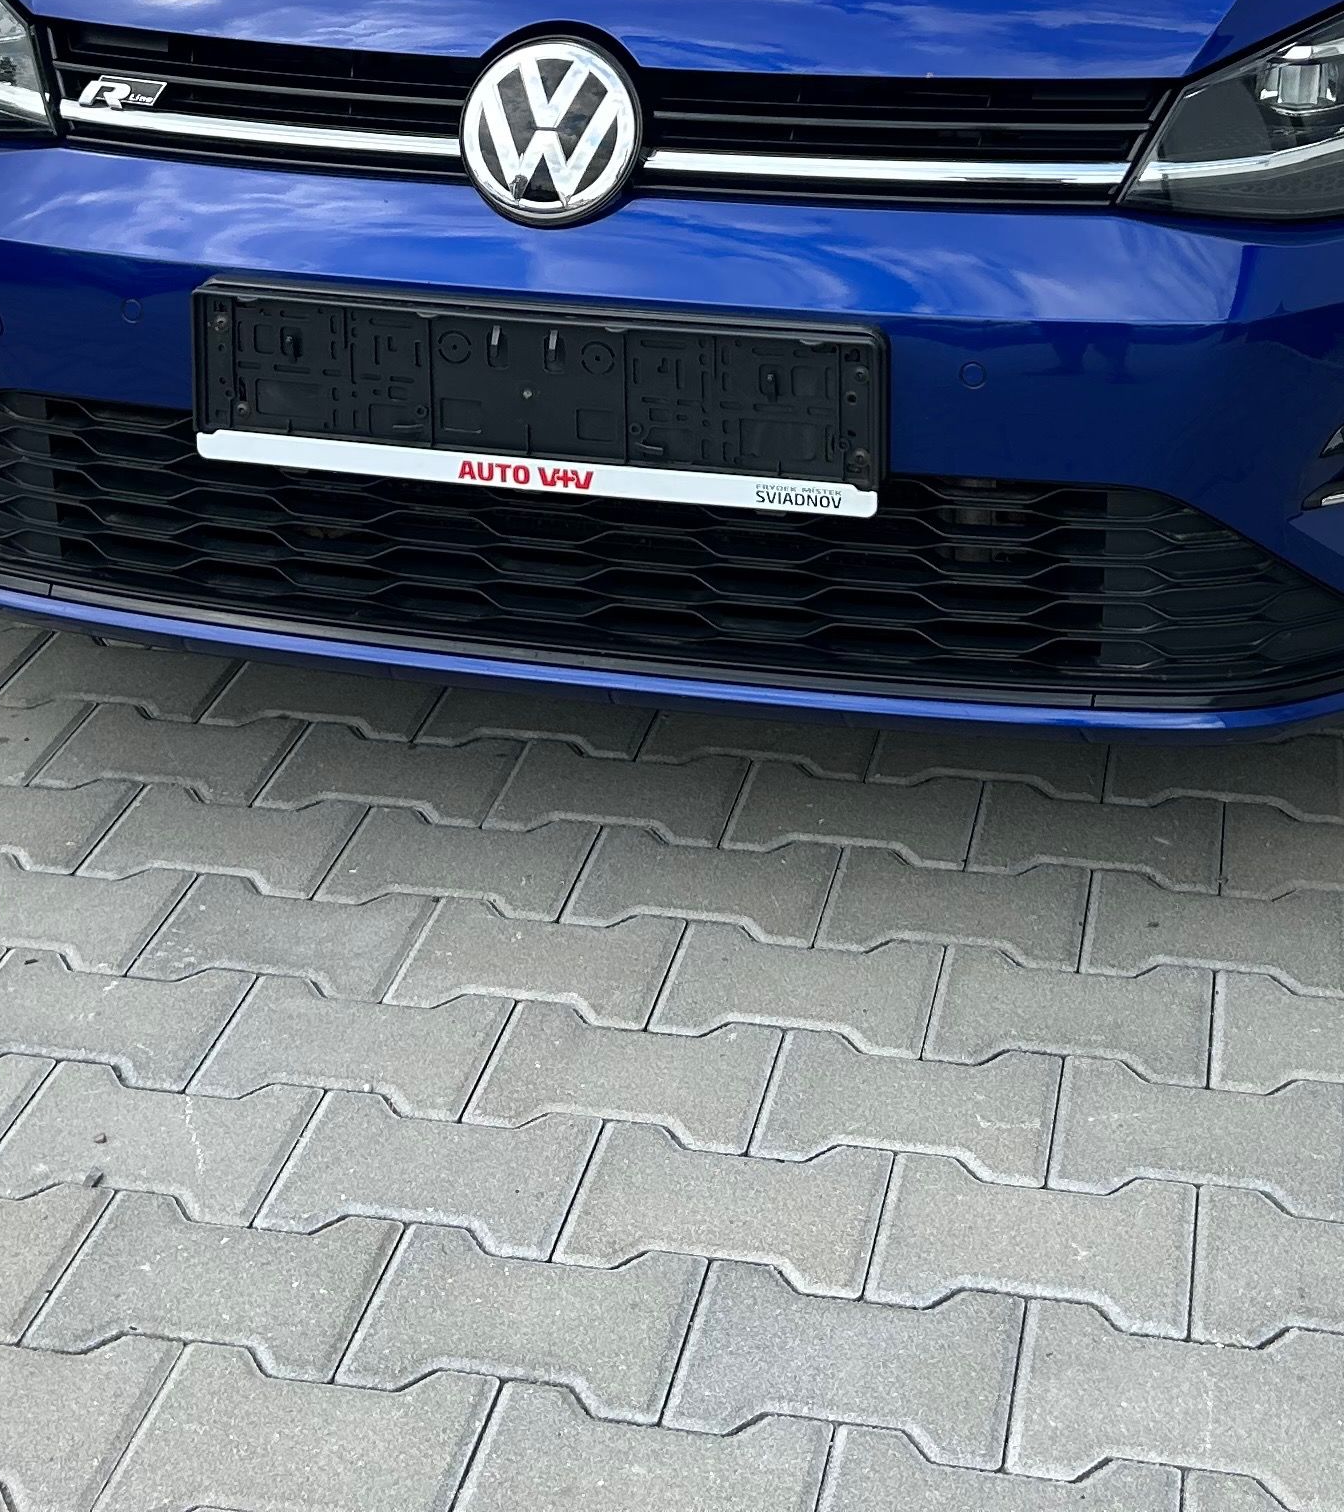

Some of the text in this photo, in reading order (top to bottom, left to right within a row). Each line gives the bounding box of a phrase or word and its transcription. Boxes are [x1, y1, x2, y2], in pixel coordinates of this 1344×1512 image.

[464, 43, 635, 214] VW
[458, 460, 531, 485] AUTO
[755, 490, 842, 509] SVIADNOV
